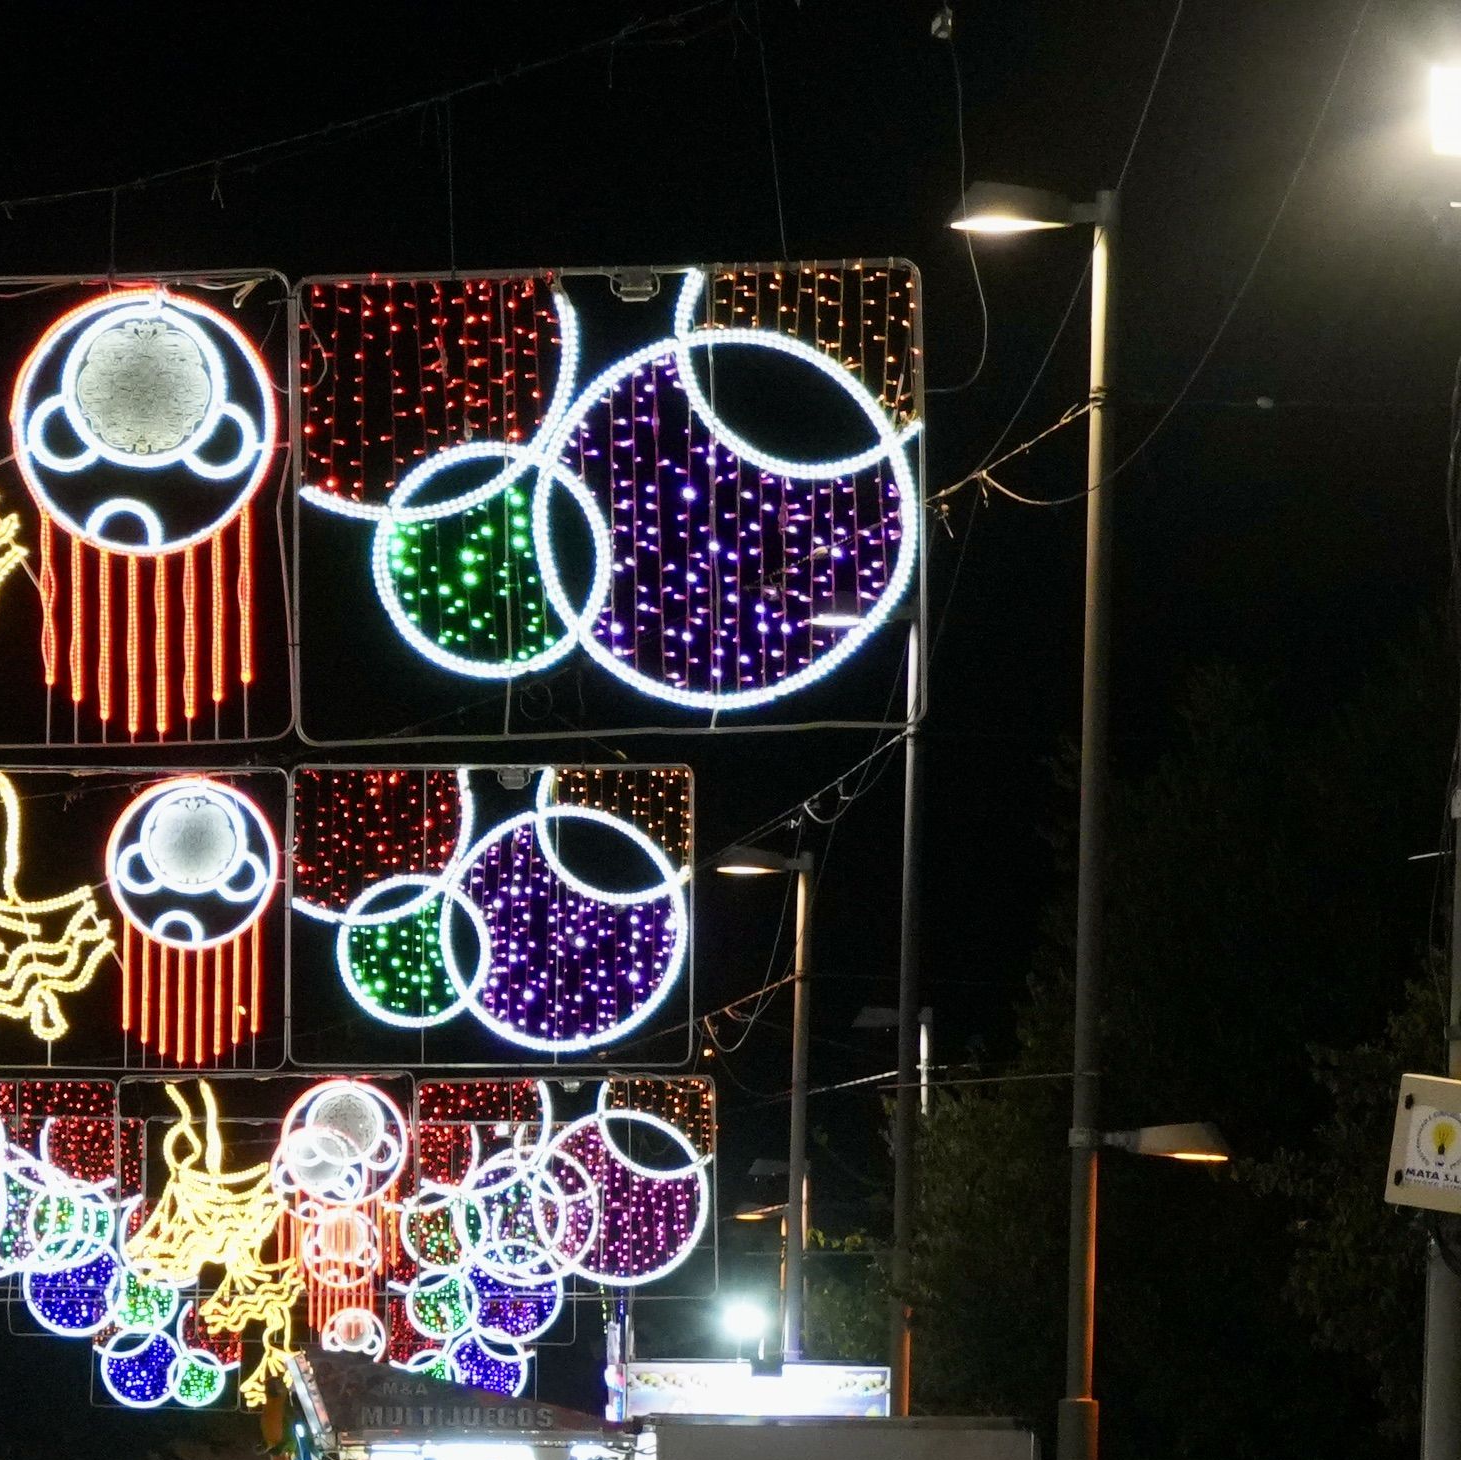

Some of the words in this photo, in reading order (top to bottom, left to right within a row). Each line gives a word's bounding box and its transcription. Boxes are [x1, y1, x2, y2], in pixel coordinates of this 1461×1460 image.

[1405, 1167, 1440, 1181] MATA
[382, 1382, 427, 1395] M&A
[361, 1405, 554, 1428] MULTIJUEGOS
